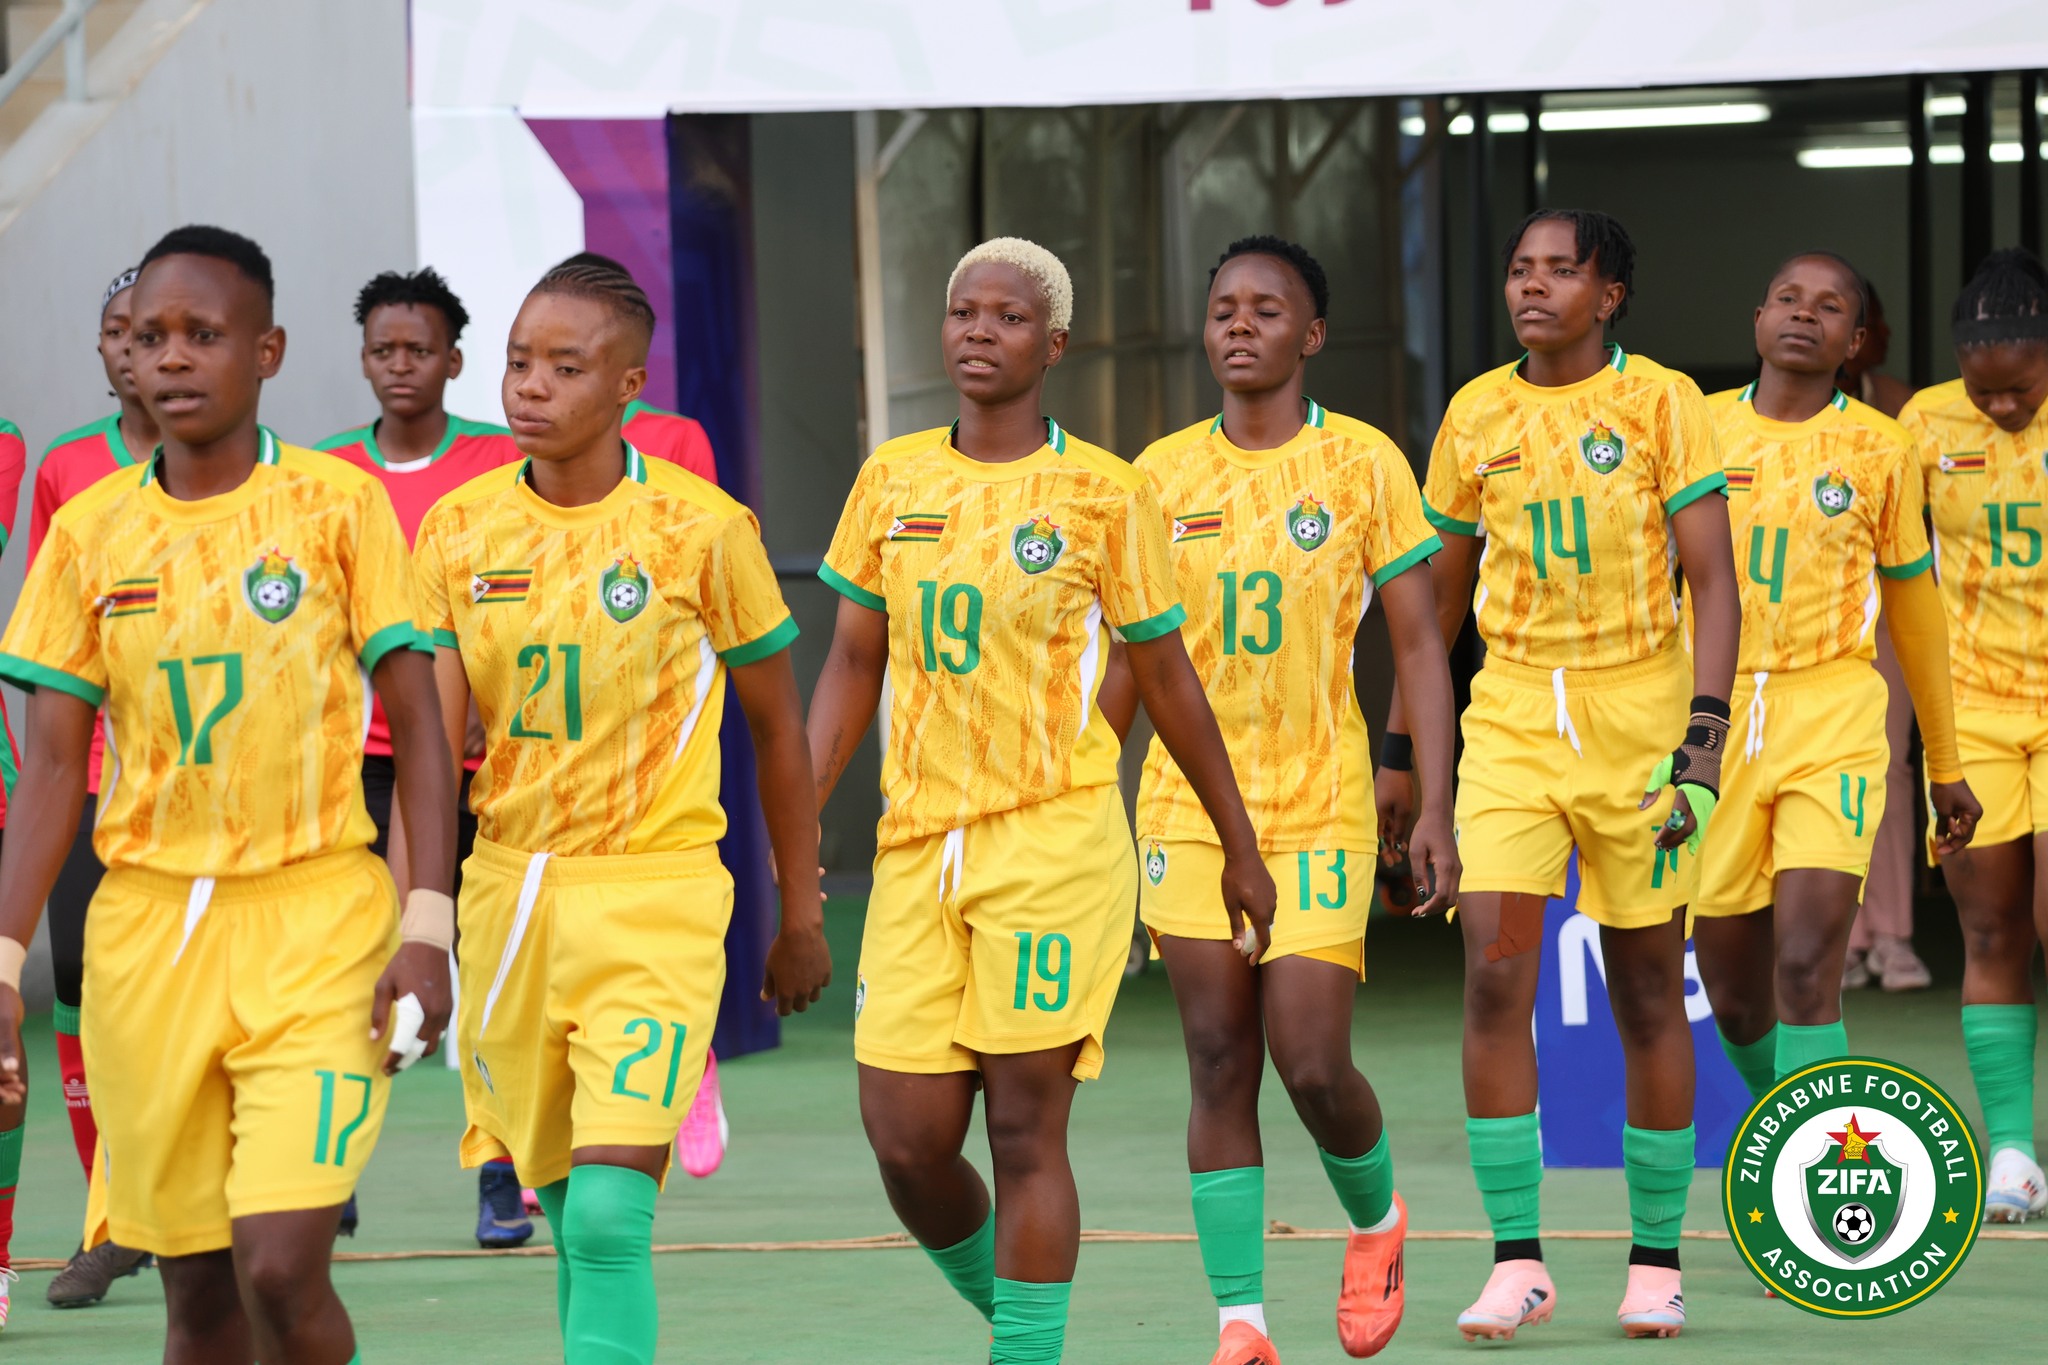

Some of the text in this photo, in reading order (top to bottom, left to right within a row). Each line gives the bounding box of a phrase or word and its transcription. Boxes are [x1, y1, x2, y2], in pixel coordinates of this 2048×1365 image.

[1524, 496, 1591, 579] 14
[1749, 526, 1788, 603] 4
[1982, 502, 2042, 567] 15
[916, 580, 984, 675] 19
[1217, 571, 1283, 655] 13
[158, 653, 244, 765] 17
[510, 643, 582, 741] 21
[1838, 773, 1868, 837] 4
[1297, 849, 1348, 911] 13
[1012, 932, 1072, 1012] 19
[611, 1017, 688, 1109] 21
[314, 1070, 373, 1167] 17
